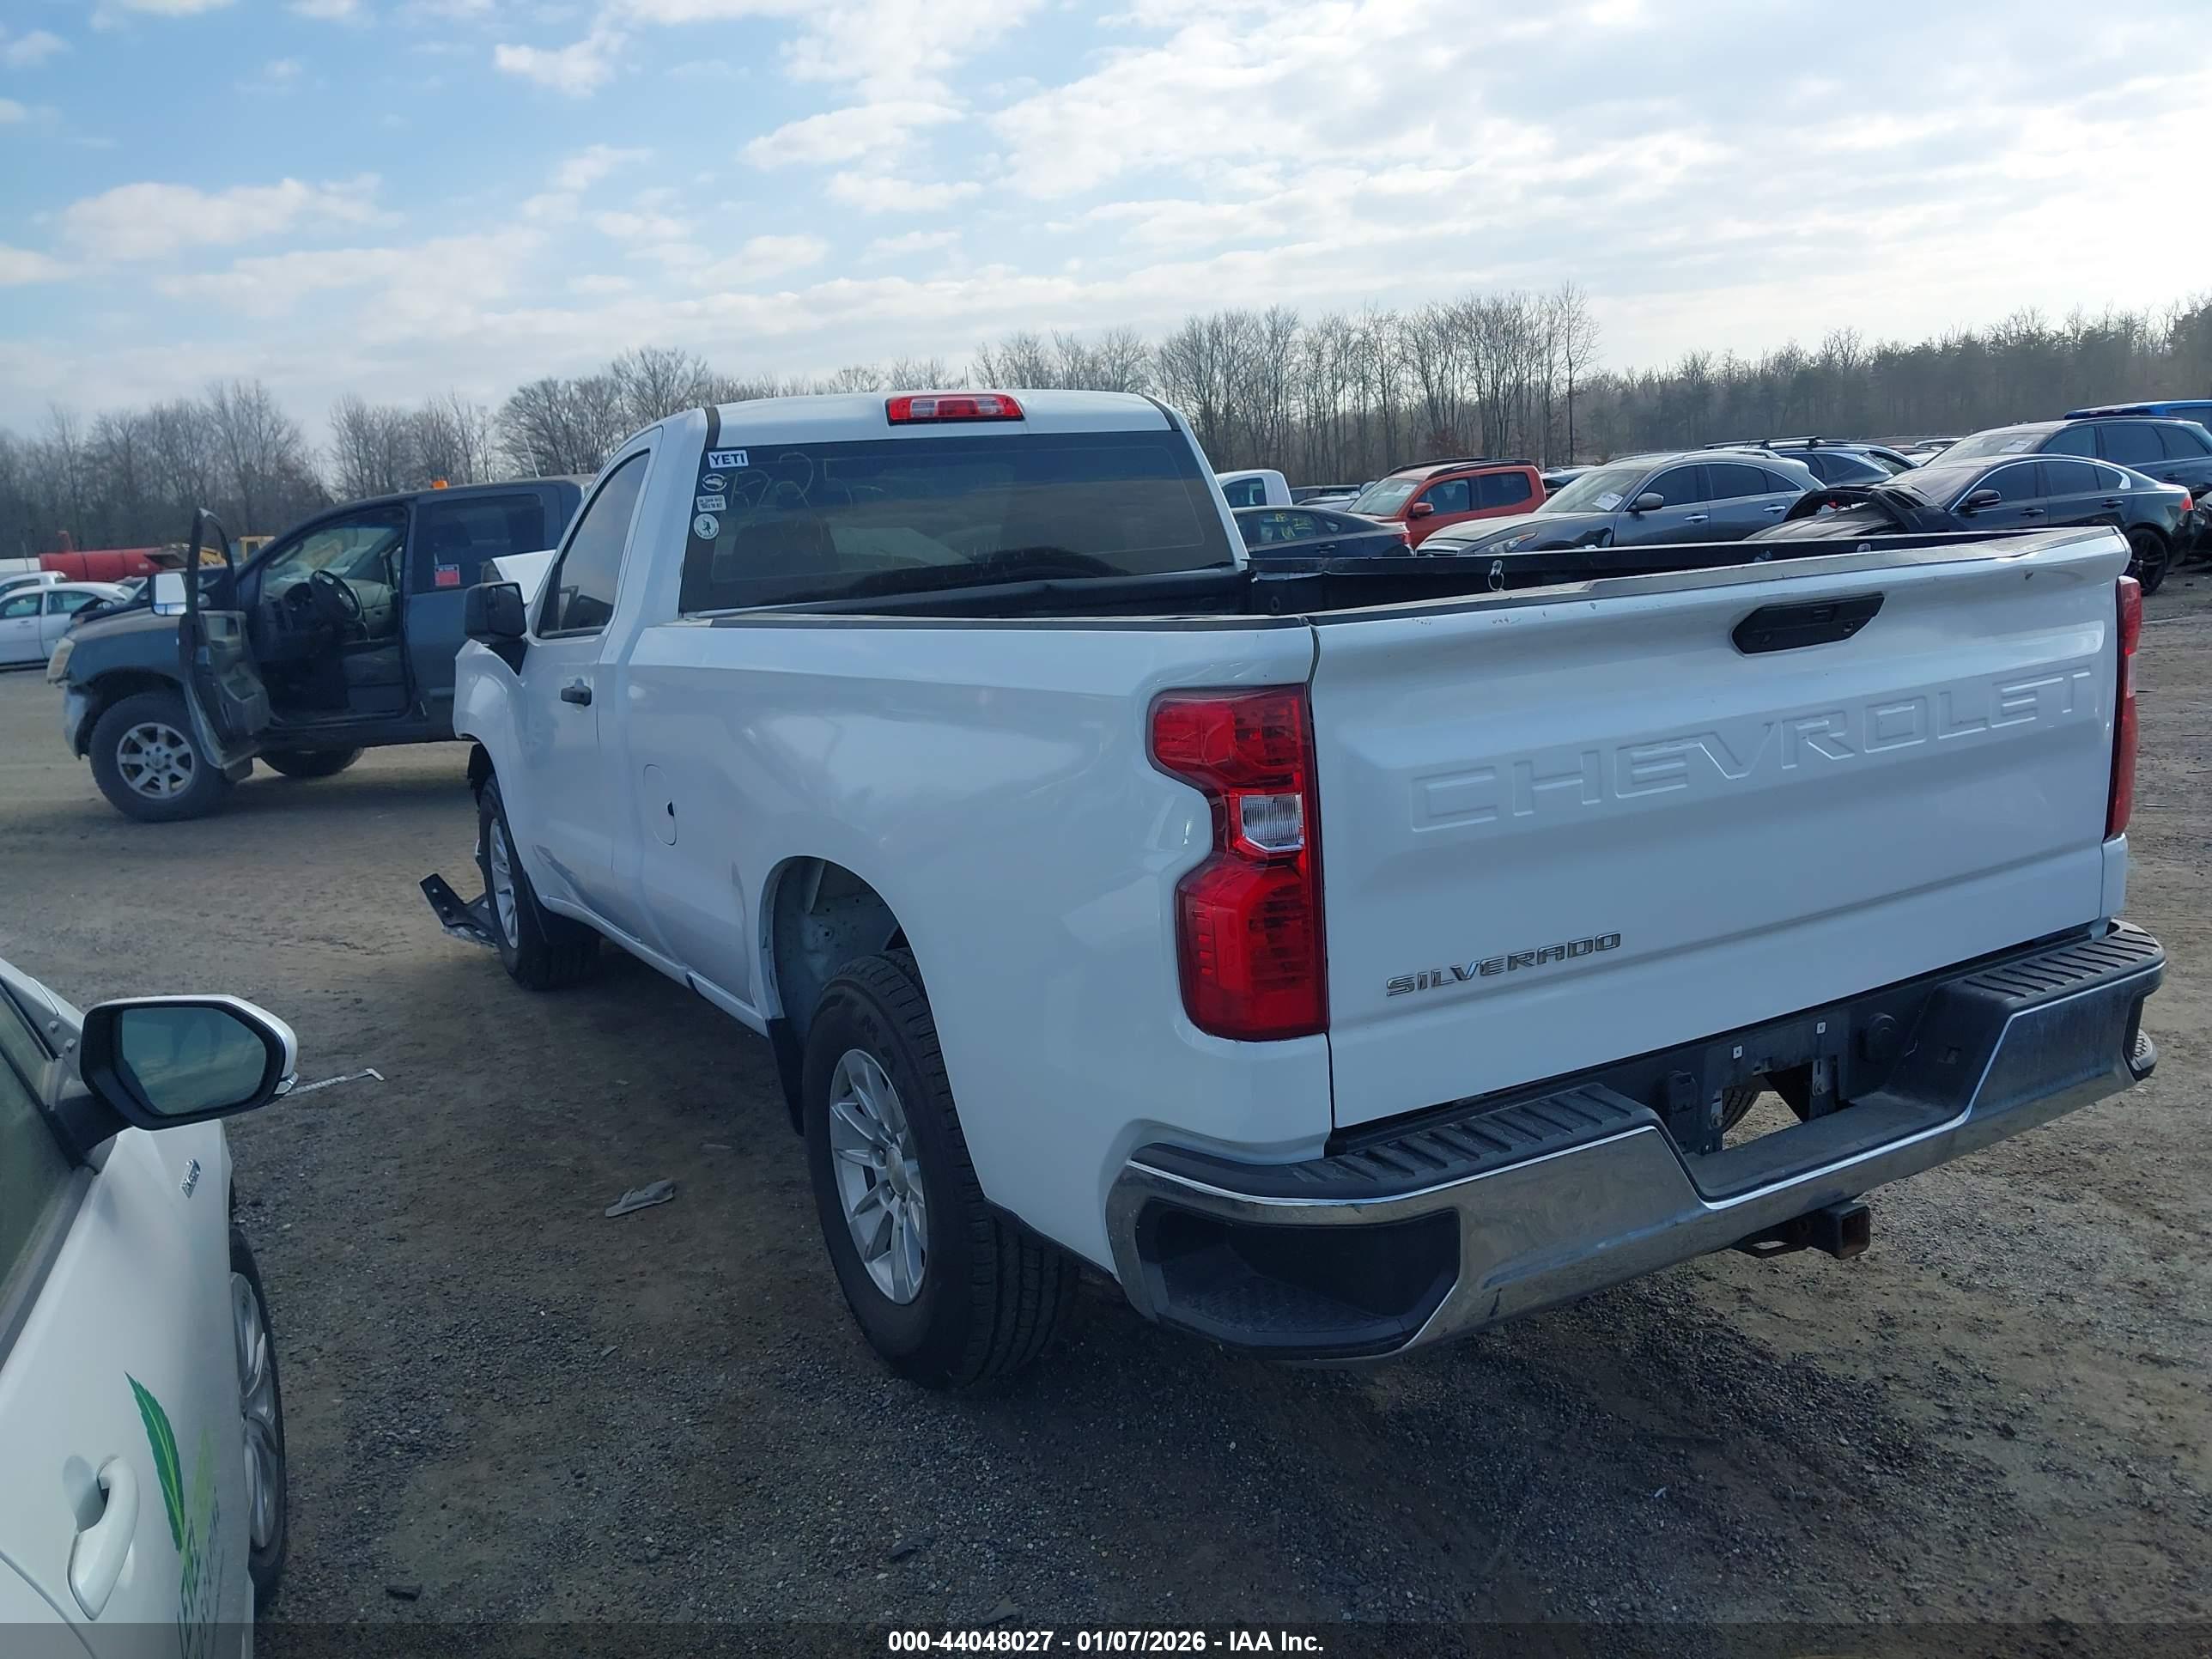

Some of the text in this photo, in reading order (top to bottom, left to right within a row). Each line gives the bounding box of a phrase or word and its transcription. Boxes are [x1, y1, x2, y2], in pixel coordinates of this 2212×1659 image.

[710, 453, 746, 465] YETI
[1411, 665, 2092, 832] CHEVROLET
[1386, 931, 1621, 996] SILVERADO
